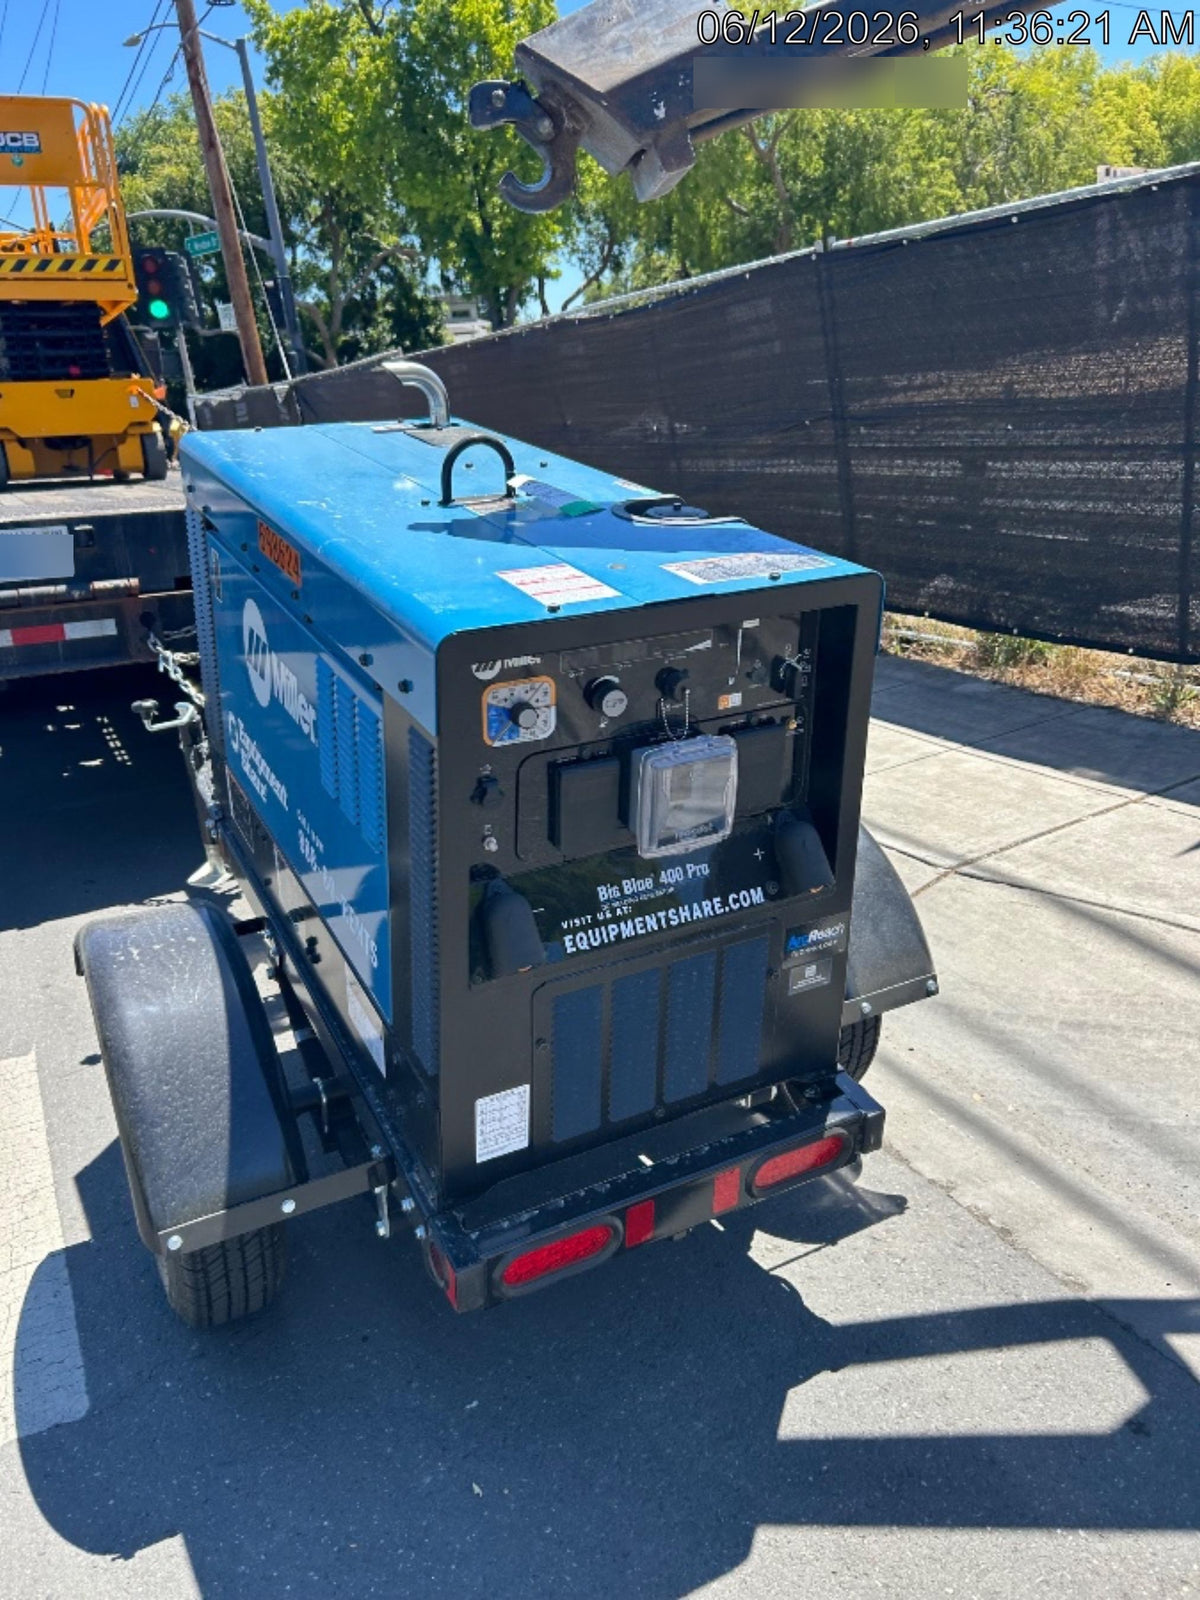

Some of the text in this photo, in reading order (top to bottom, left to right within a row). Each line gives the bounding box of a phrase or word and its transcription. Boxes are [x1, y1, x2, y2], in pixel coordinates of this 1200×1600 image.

[271, 650, 317, 747] Miller
[659, 868, 684, 884] 400
[686, 863, 710, 879] Pro
[561, 915, 592, 930] VISIT
[616, 905, 632, 917] AT:
[563, 887, 766, 954] EQUIPMENTSHARE.COM
